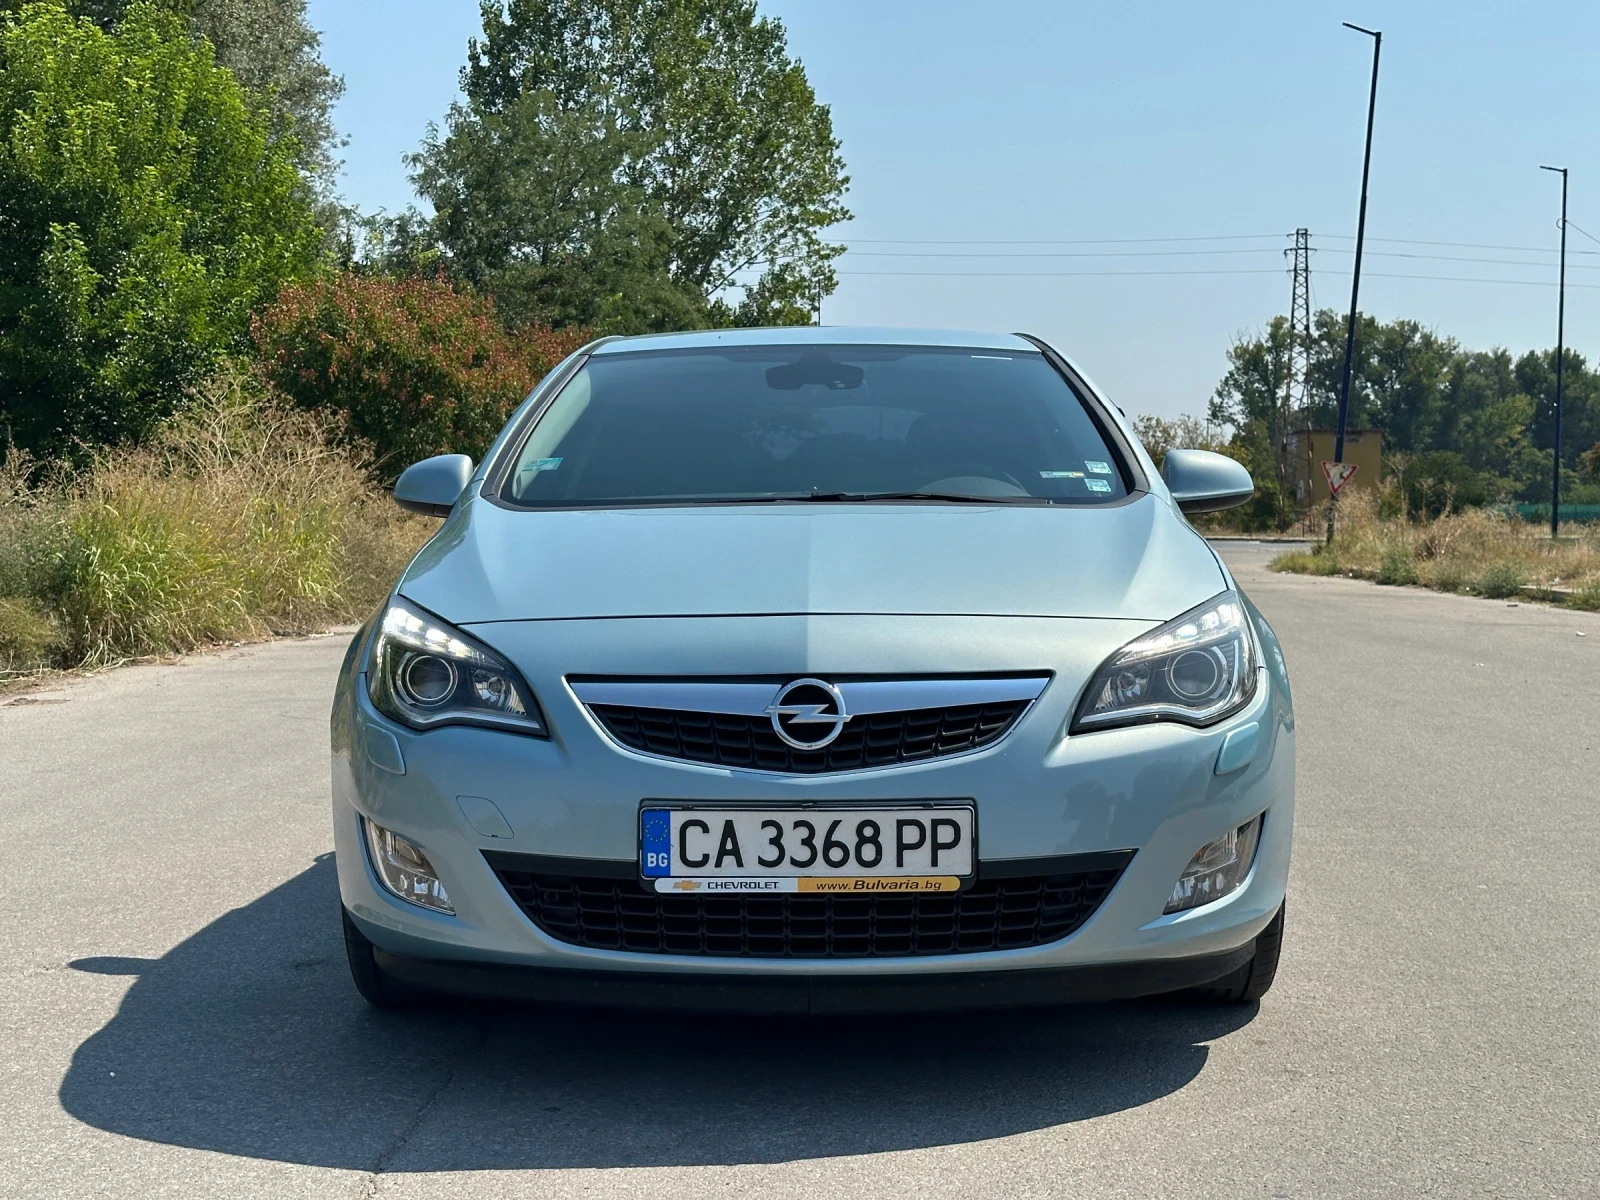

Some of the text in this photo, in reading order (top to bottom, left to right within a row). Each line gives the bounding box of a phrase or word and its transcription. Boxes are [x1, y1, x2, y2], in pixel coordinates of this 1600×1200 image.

[679, 818, 961, 868] CA 3368 PP
[647, 852, 668, 867] BG
[707, 881, 780, 890] CHEVROLET
[816, 879, 942, 891] www.Bulvaria.bg
